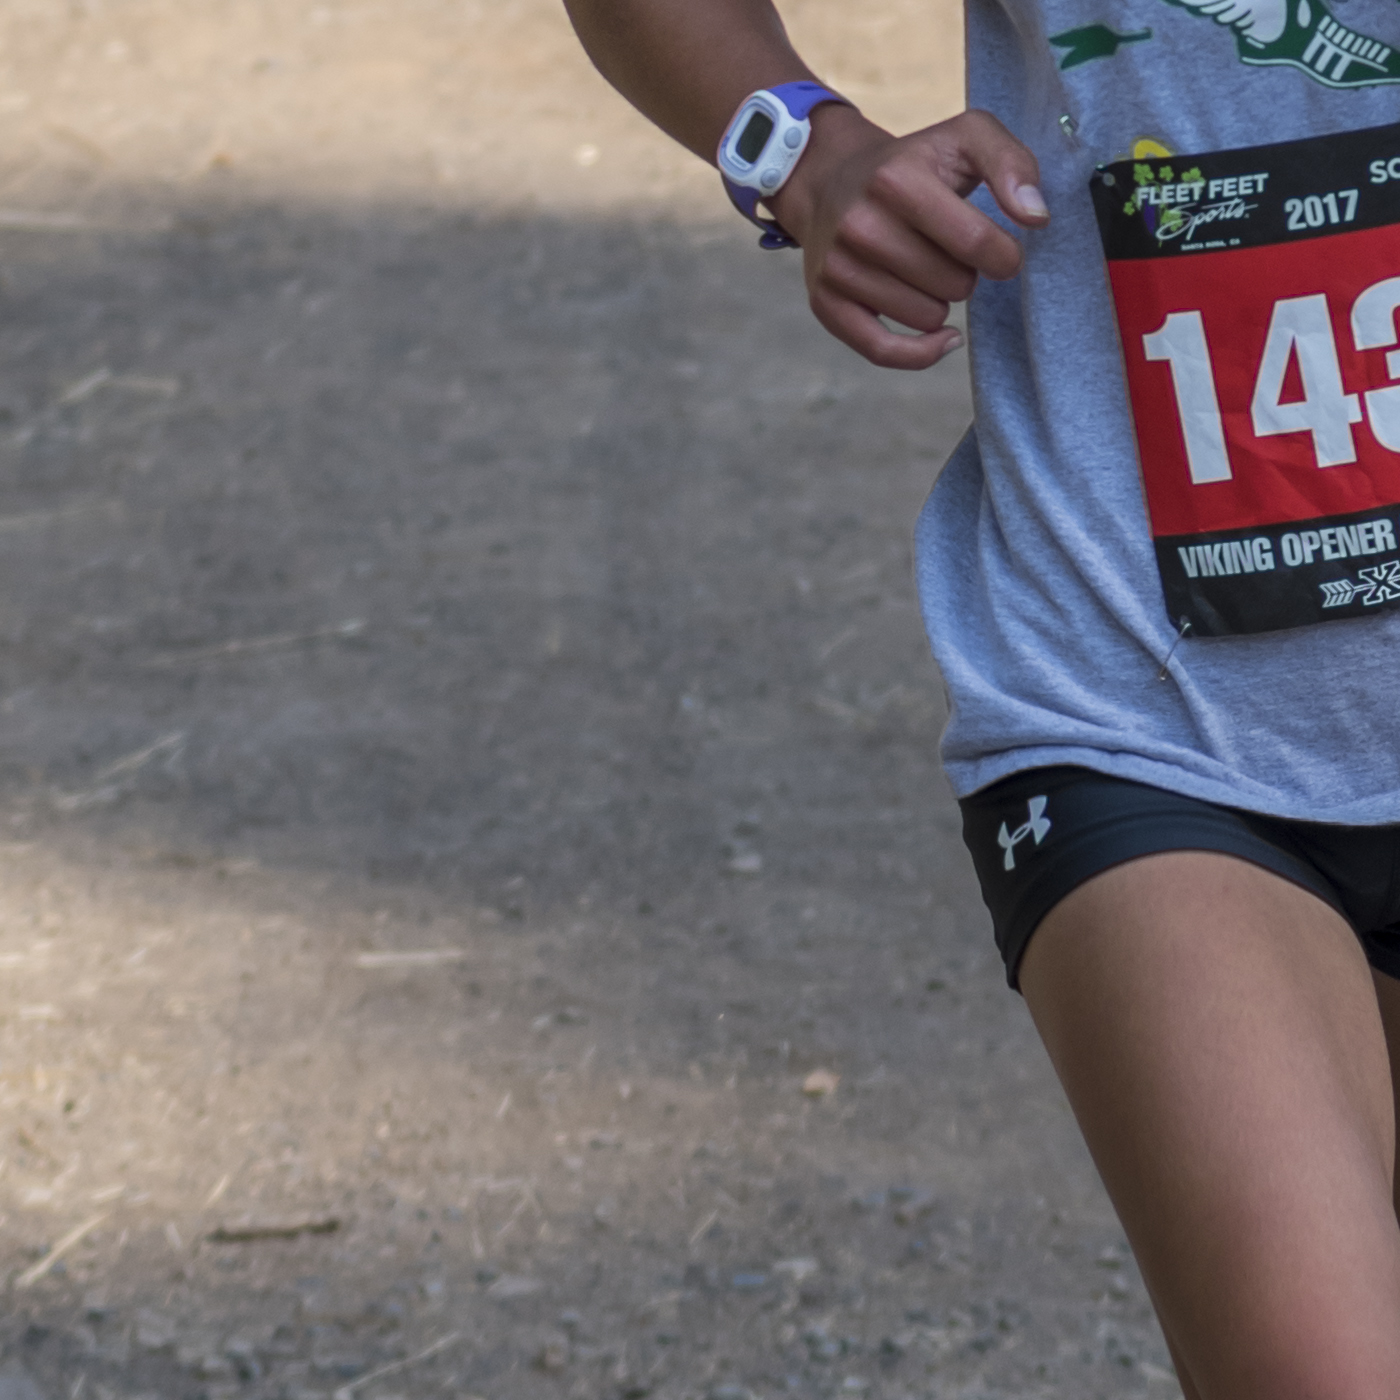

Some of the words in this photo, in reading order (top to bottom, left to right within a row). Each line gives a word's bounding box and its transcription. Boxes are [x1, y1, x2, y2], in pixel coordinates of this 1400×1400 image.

[1136, 180, 1206, 210] FLEET
[1209, 172, 1269, 199] FEET
[1284, 188, 1359, 231] 2017
[1155, 197, 1258, 240] Sports
[1178, 537, 1275, 578] VIKING
[1281, 518, 1397, 568] OPENER
